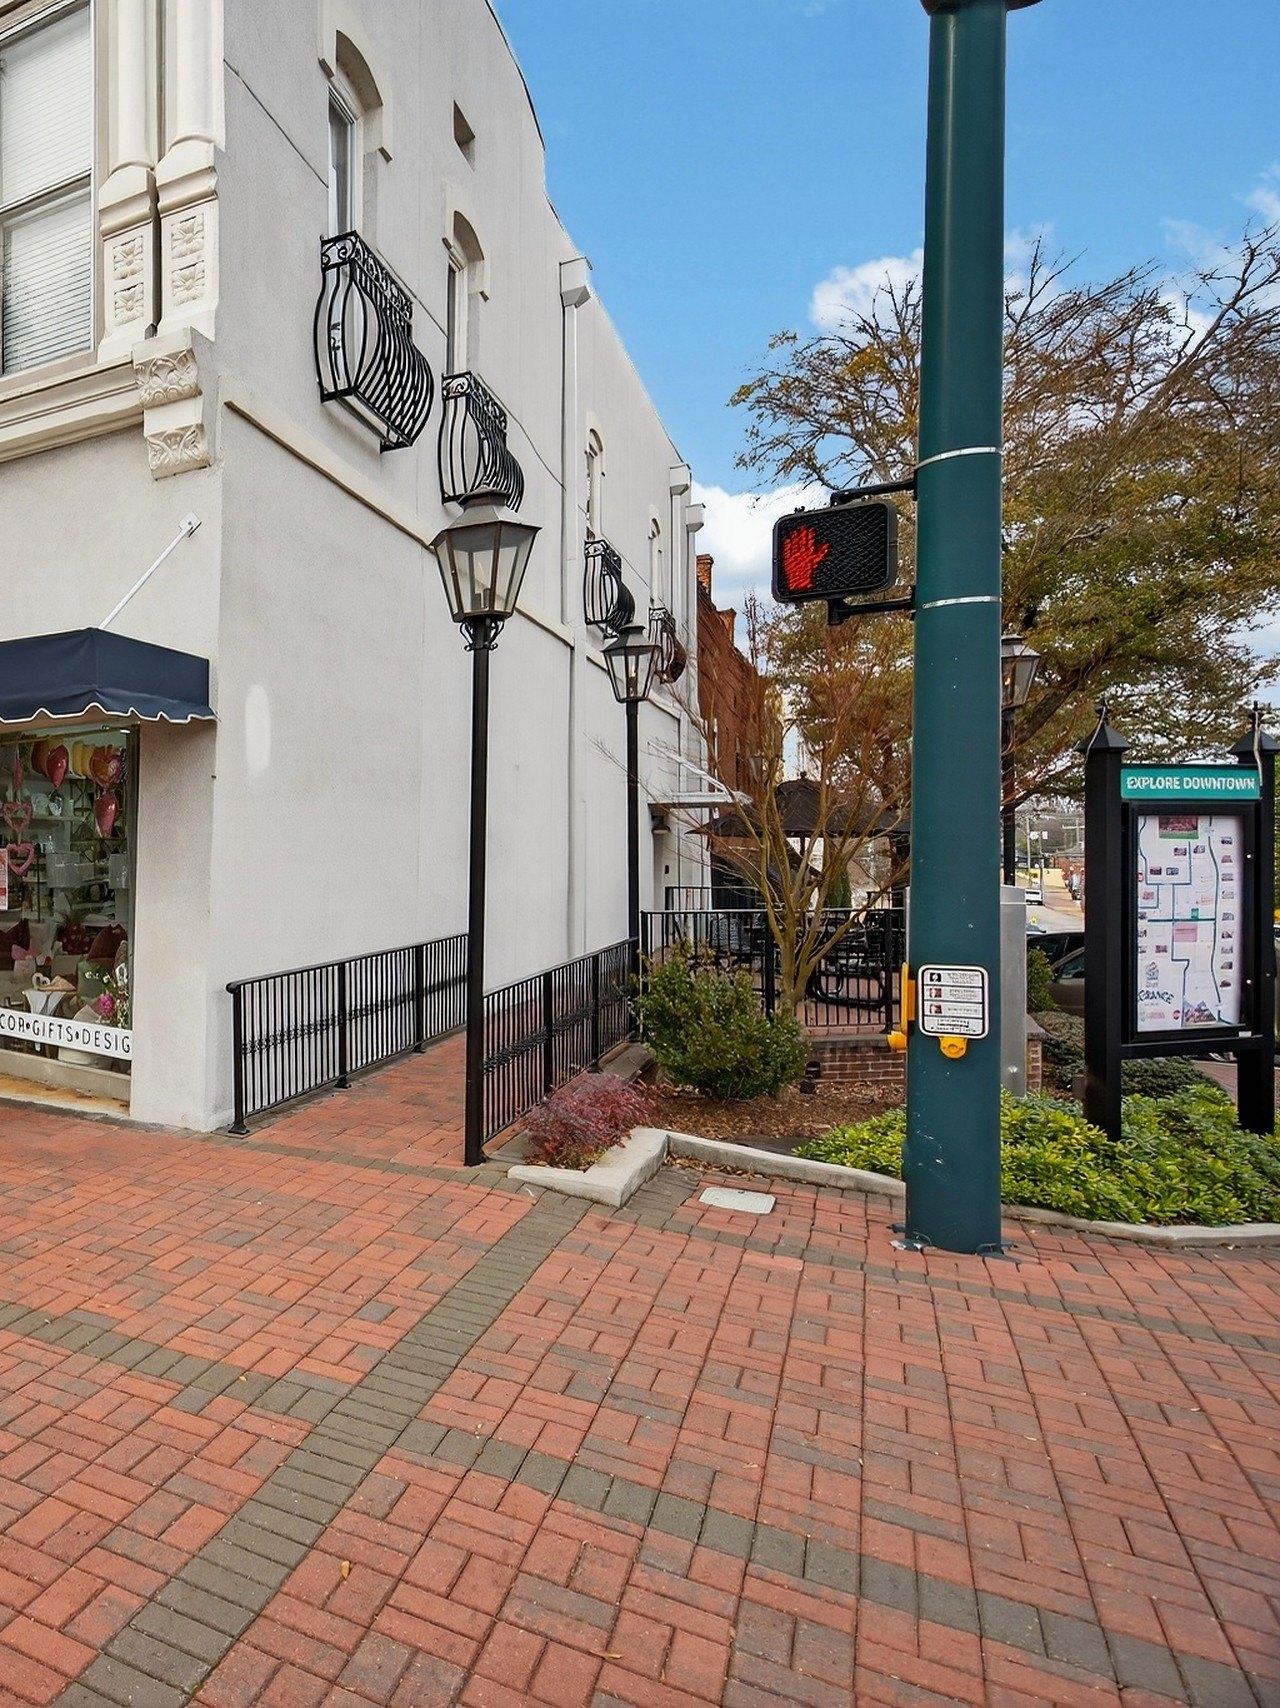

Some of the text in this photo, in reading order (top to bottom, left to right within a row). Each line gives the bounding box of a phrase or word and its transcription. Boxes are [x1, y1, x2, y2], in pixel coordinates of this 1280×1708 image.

[1126, 776, 1255, 790] EXPLORE DOWNTOWN
[32, 1019, 74, 1042] GIFTS
[82, 1028, 131, 1053] DESIG
